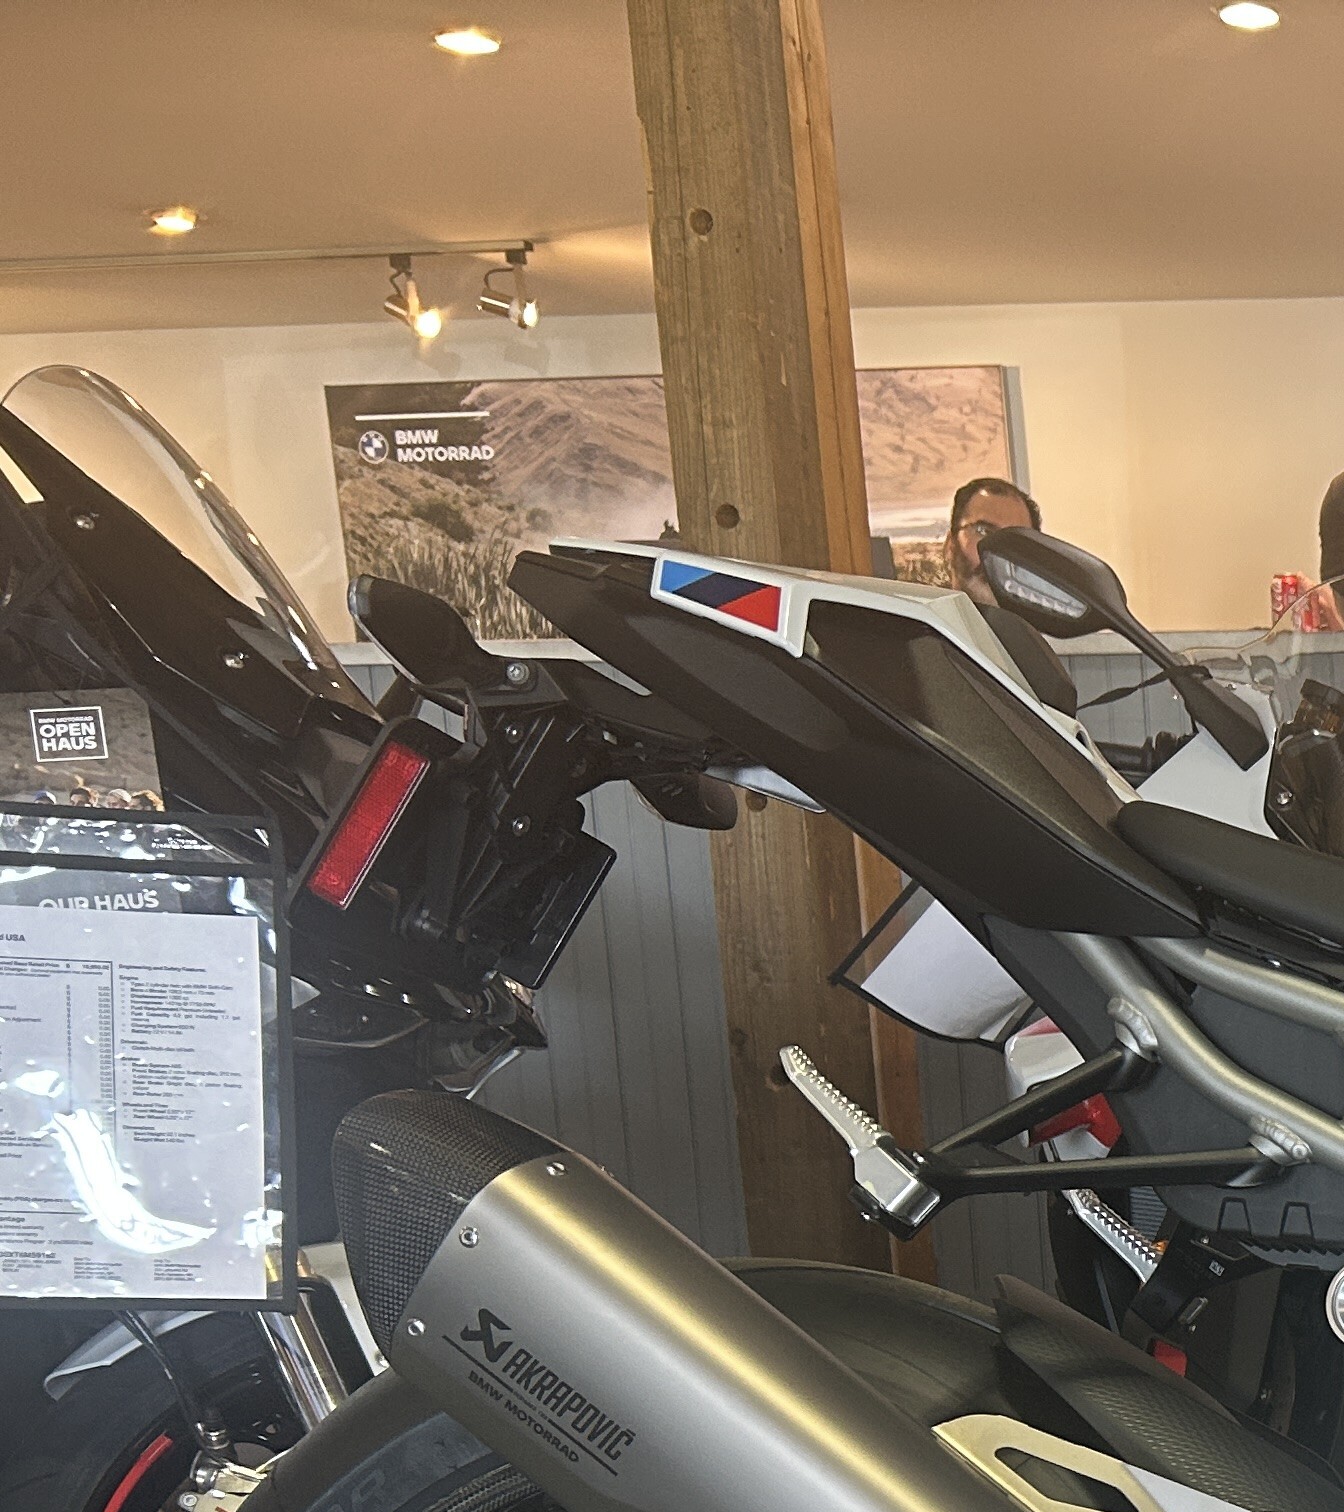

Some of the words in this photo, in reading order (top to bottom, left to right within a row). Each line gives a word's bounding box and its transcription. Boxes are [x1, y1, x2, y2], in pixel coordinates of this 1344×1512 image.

[394, 429, 439, 445] BMW
[397, 445, 495, 462] MOTORRAD
[39, 722, 96, 738] OPEN
[42, 735, 97, 751] HAUS
[93, 889, 159, 910] HAUS
[502, 1348, 637, 1461] AKRAPOVIČ
[468, 1370, 503, 1400] BMW
[504, 1399, 579, 1462] MOTORRAD
